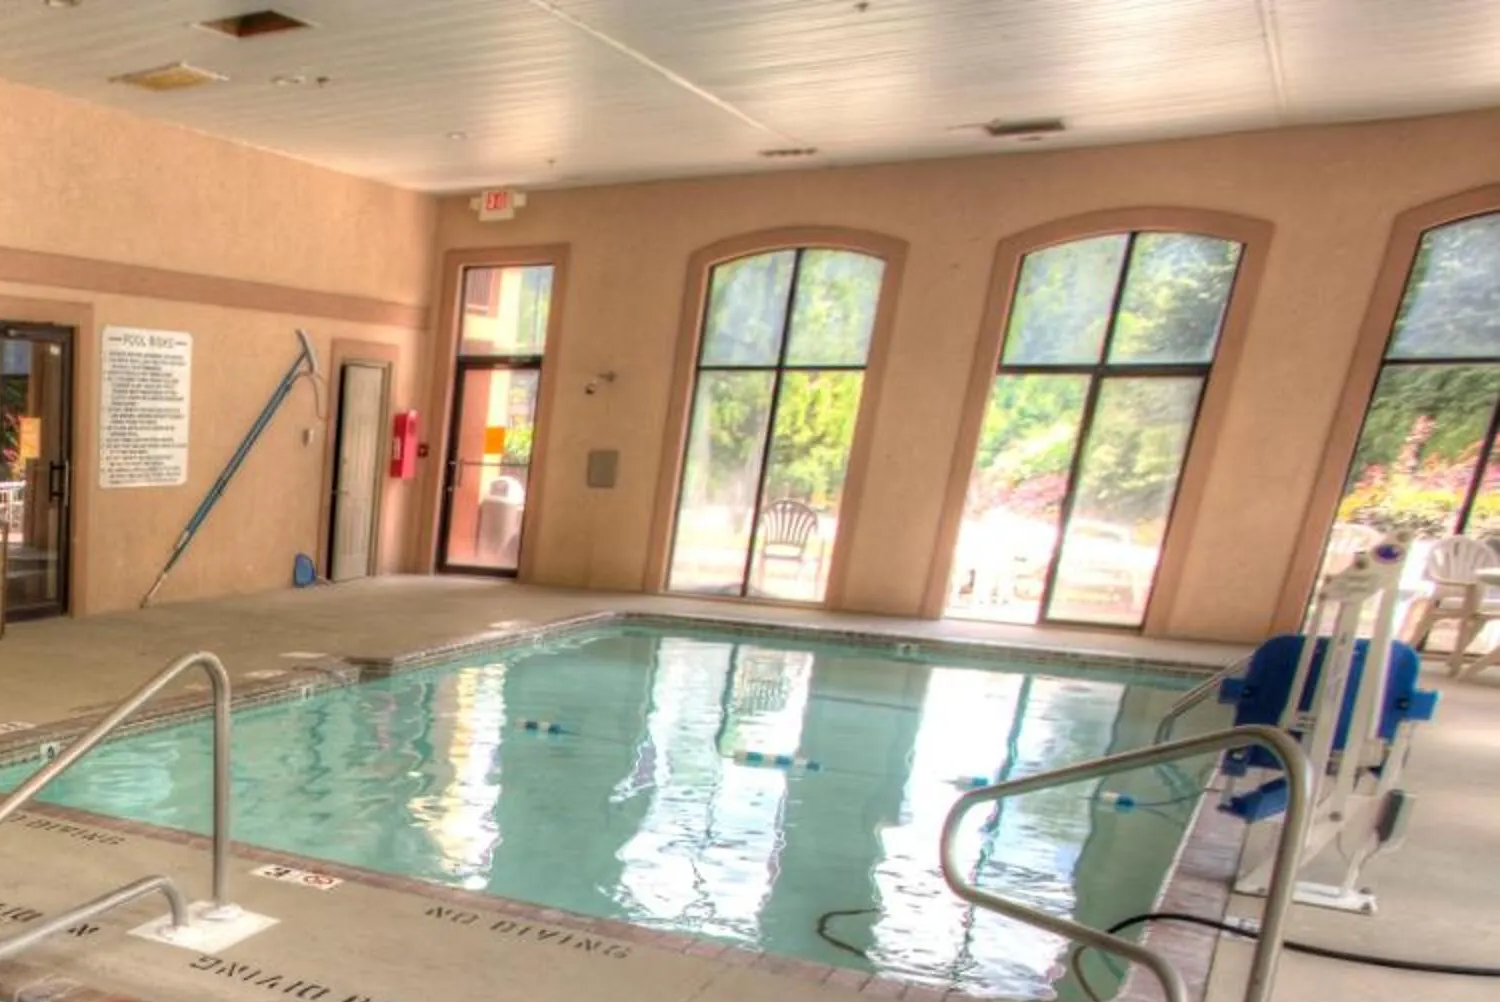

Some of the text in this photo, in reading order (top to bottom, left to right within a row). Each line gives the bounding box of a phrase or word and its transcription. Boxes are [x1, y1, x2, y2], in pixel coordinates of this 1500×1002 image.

[425, 906, 632, 959] NO DIVING
[189, 955, 331, 1001] DIVING
